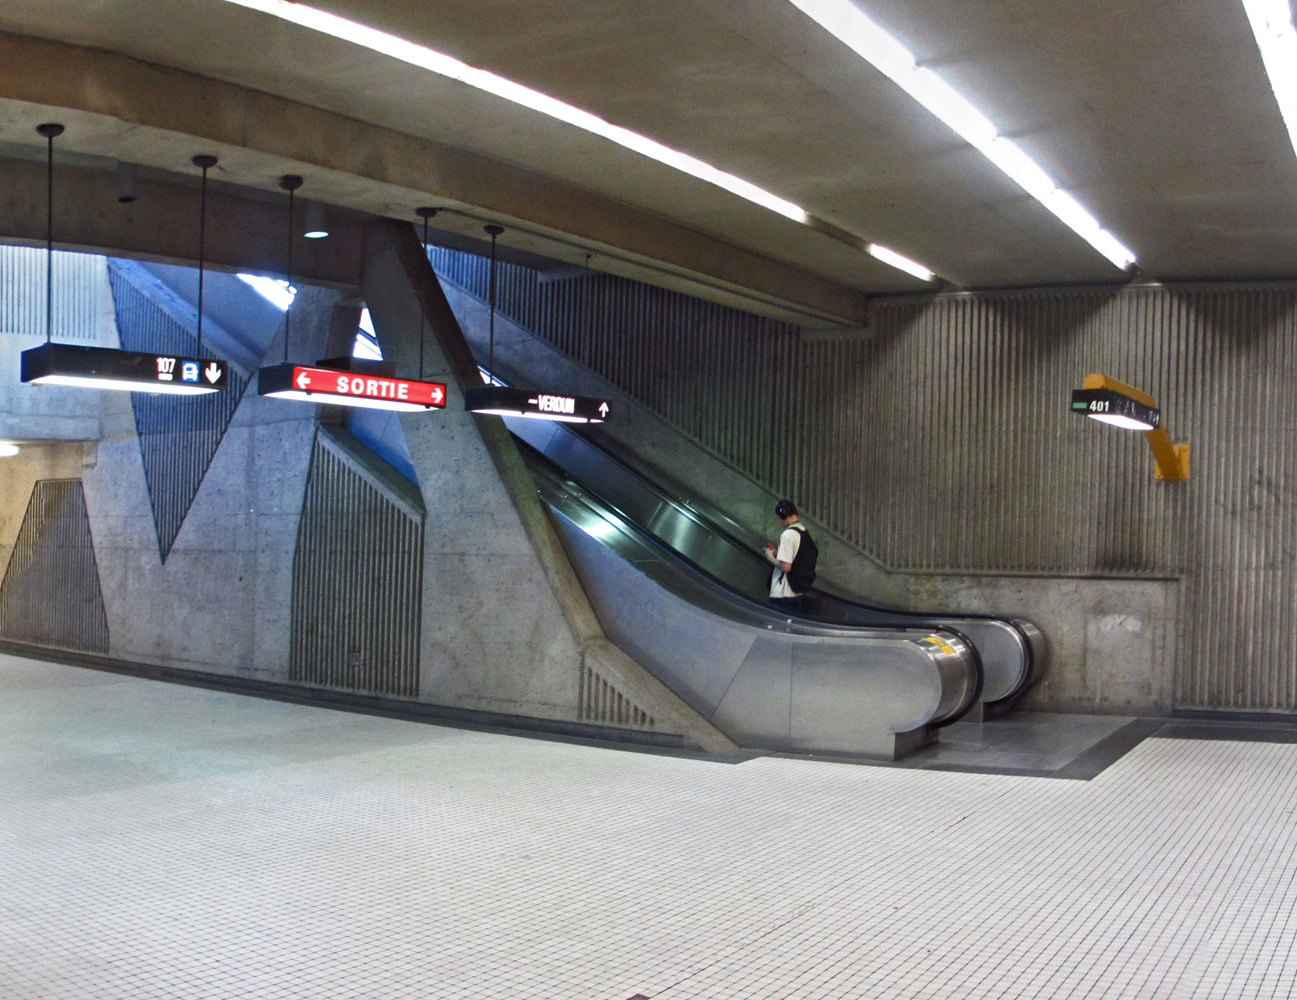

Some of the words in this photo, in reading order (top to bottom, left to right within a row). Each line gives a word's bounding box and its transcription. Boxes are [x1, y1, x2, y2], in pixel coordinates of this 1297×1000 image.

[156, 357, 176, 373] 107
[336, 376, 409, 399] SORTIE
[538, 394, 575, 414] VERDUN
[1089, 400, 1109, 412] 401
